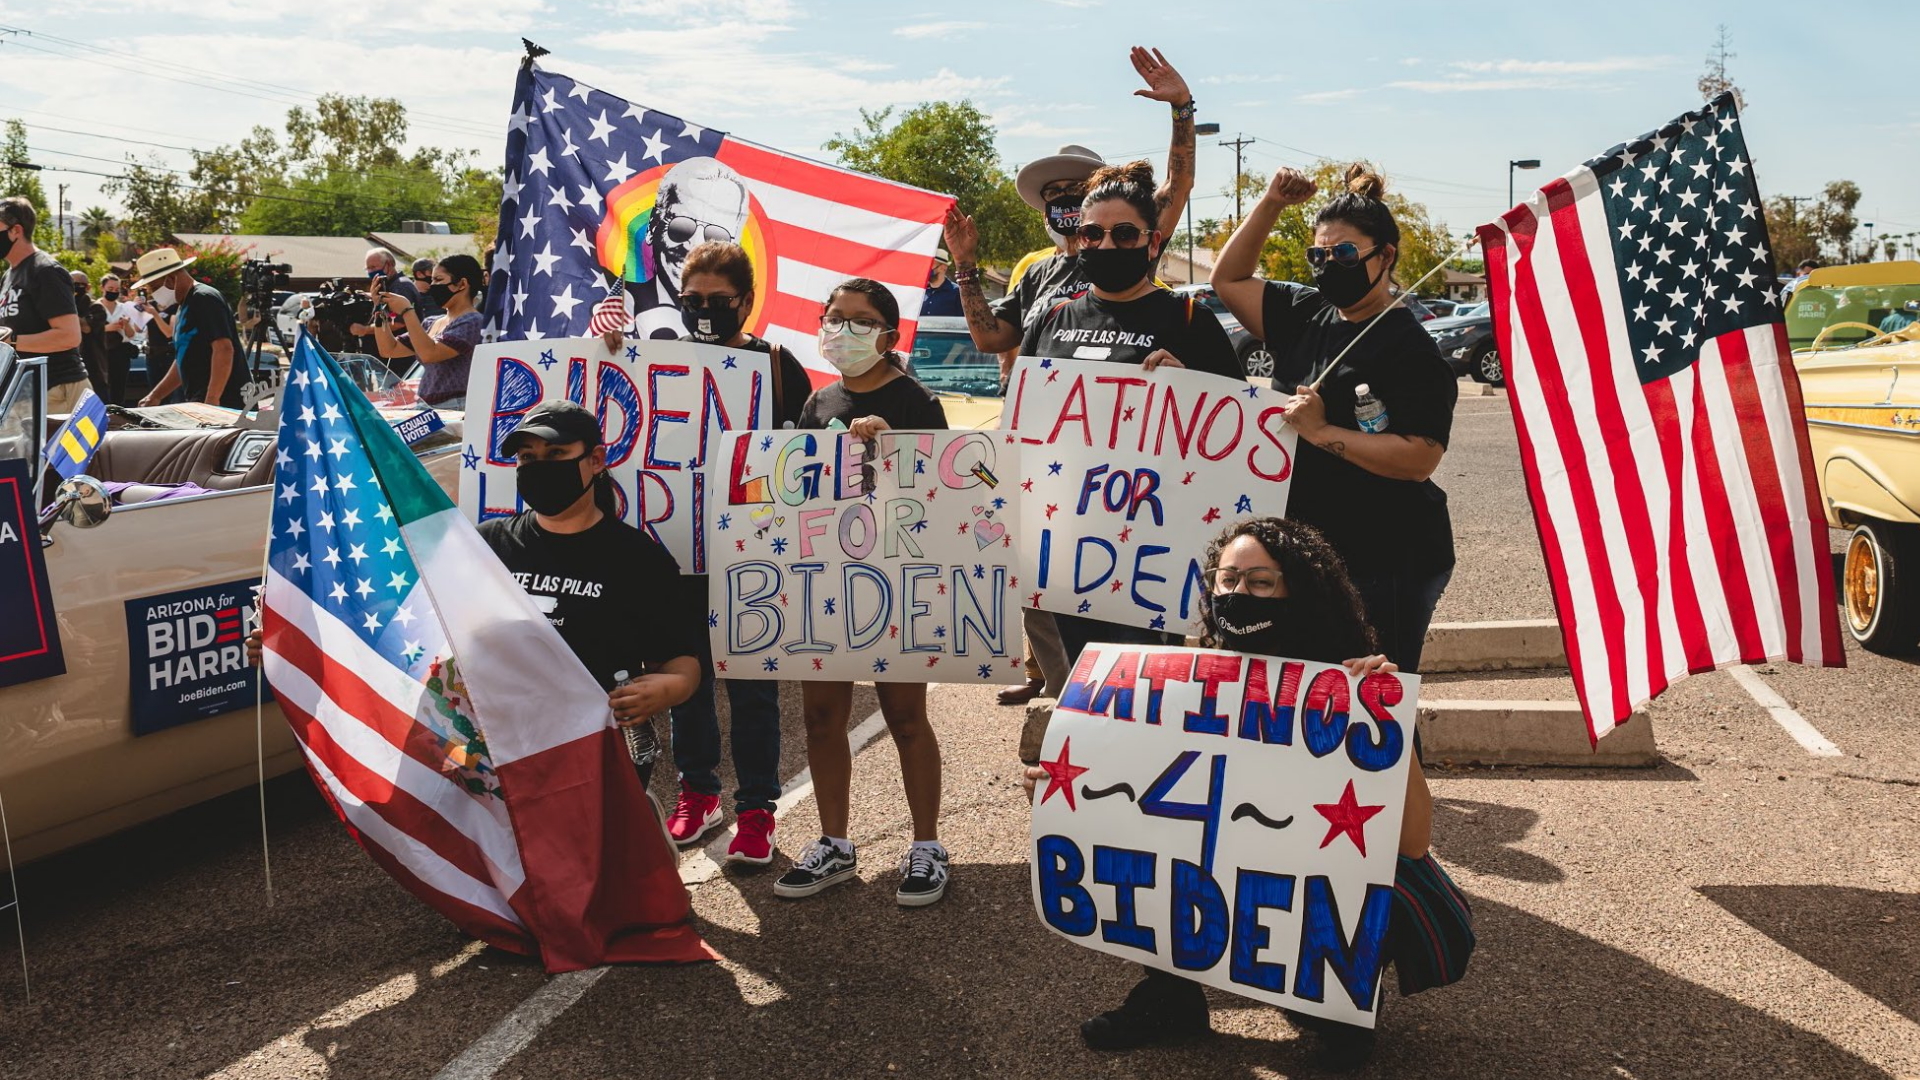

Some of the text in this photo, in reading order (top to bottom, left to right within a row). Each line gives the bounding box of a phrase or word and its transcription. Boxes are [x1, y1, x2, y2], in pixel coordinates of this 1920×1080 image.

[1056, 216, 1081, 228] 202
[1053, 328, 1154, 347] PONTE LAS PILAS
[400, 410, 436, 434] EQUALITY
[404, 424, 431, 442] VOTER
[485, 357, 762, 471] BIDEN
[1011, 368, 1291, 482] LATINOS
[728, 432, 999, 506] LGBTQ
[1076, 463, 1163, 526] FOR
[799, 498, 925, 560] FOR
[512, 572, 603, 598] TE LAS PILAS
[1038, 529, 1206, 619] IDEN
[146, 593, 235, 621] ARIZONA for
[725, 560, 1009, 657] BIDEN
[1226, 622, 1246, 635] Select
[149, 643, 250, 691] HARRI
[178, 680, 246, 703] JoeBiden.com
[1056, 650, 1404, 772] LATINOS
[1037, 835, 1394, 1012] BIDEN
